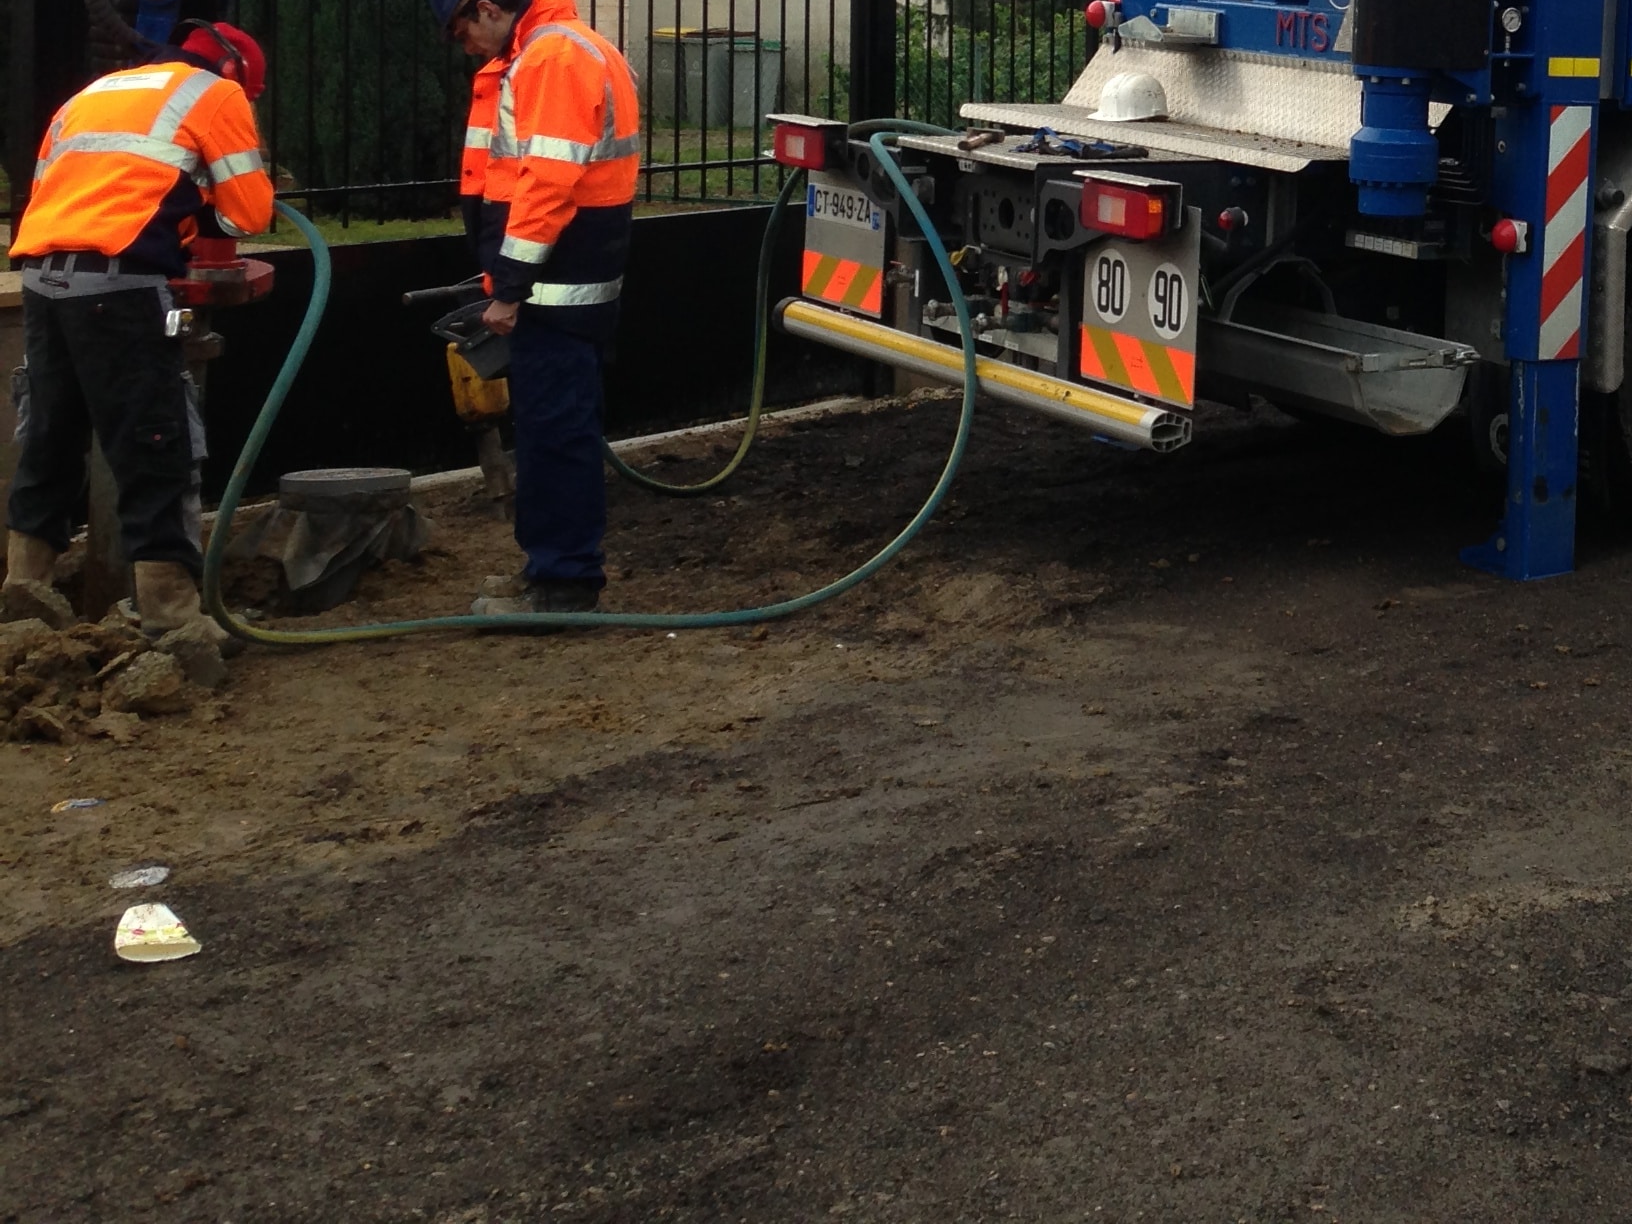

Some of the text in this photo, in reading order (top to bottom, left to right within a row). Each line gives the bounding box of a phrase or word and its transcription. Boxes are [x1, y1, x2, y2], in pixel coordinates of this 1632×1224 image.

[1276, 11, 1329, 53] MTS
[1097, 256, 1125, 316] 80
[1153, 270, 1182, 332] 90
